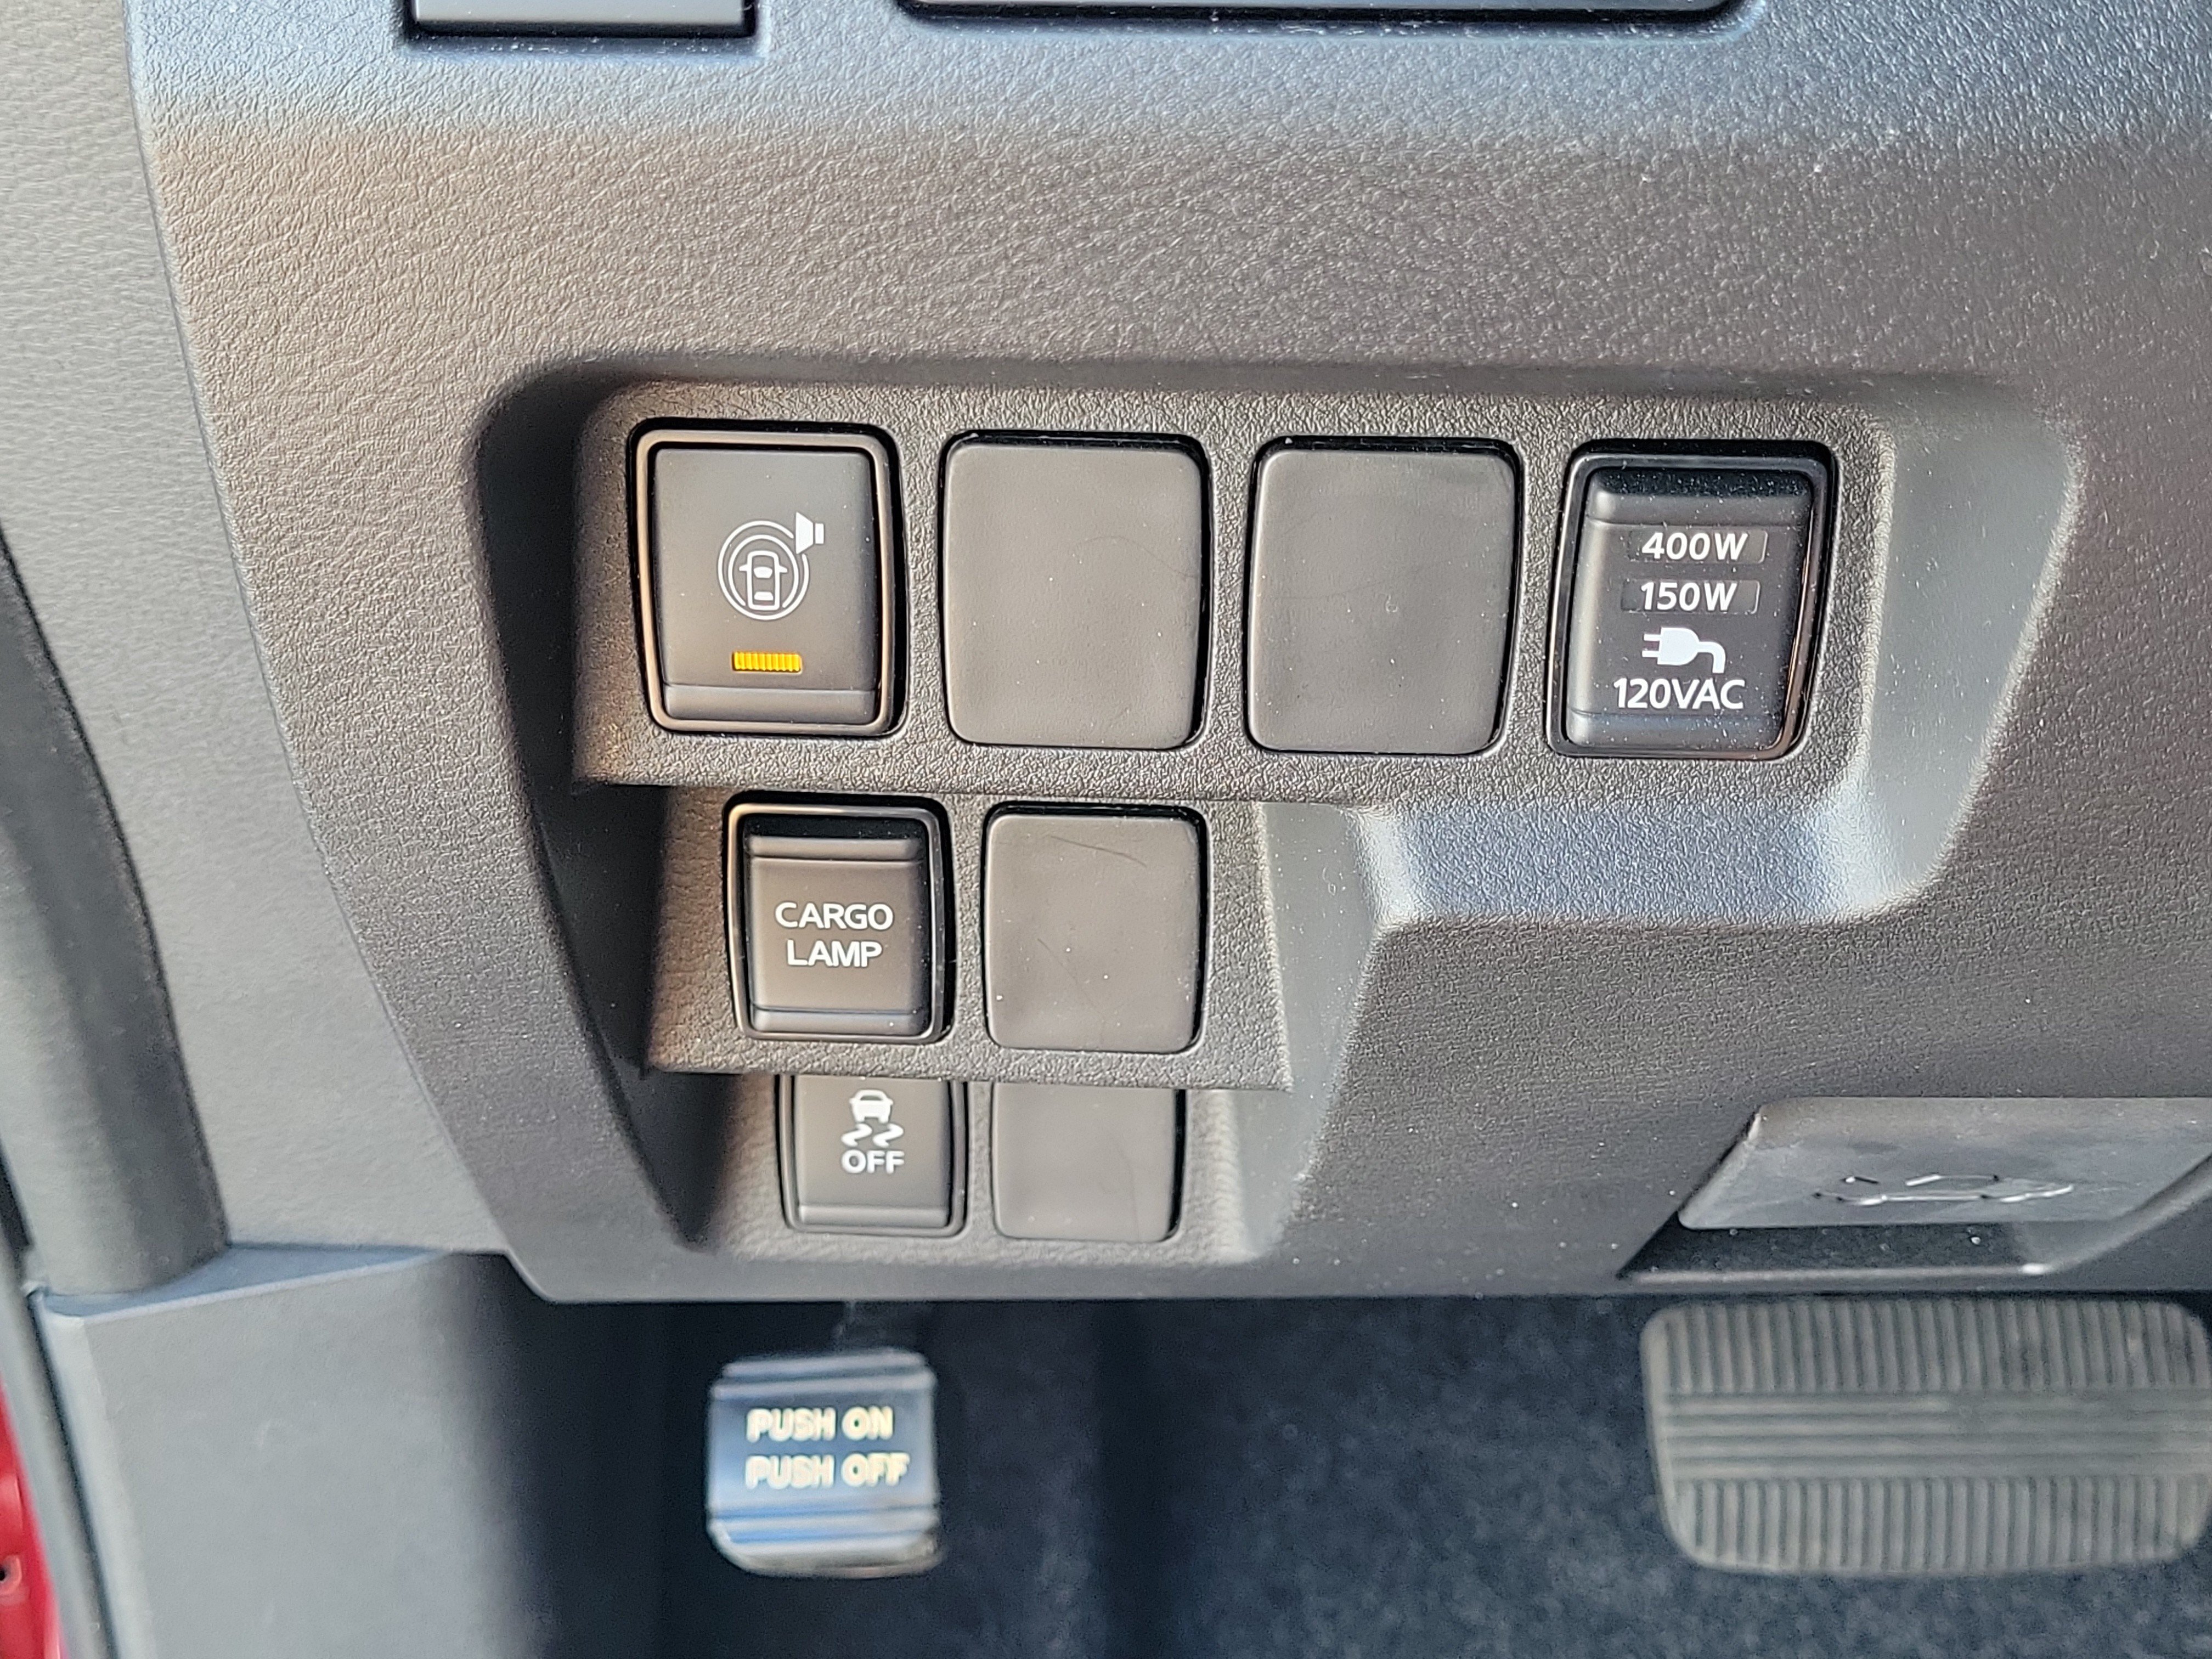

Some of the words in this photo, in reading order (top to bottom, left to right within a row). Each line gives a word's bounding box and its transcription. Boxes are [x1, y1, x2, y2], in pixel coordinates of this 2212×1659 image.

[1641, 532, 1748, 560] 400W
[1641, 582, 1737, 611] 150W
[1613, 678, 1745, 709] 120VAC
[775, 902, 894, 930] CARGO
[786, 939, 883, 967] LAMP
[840, 1150, 905, 1173] OFF
[746, 1407, 836, 1442] PUSH
[842, 1406, 894, 1440] ON
[745, 1455, 835, 1489] PUSH
[841, 1453, 910, 1487] OFF
